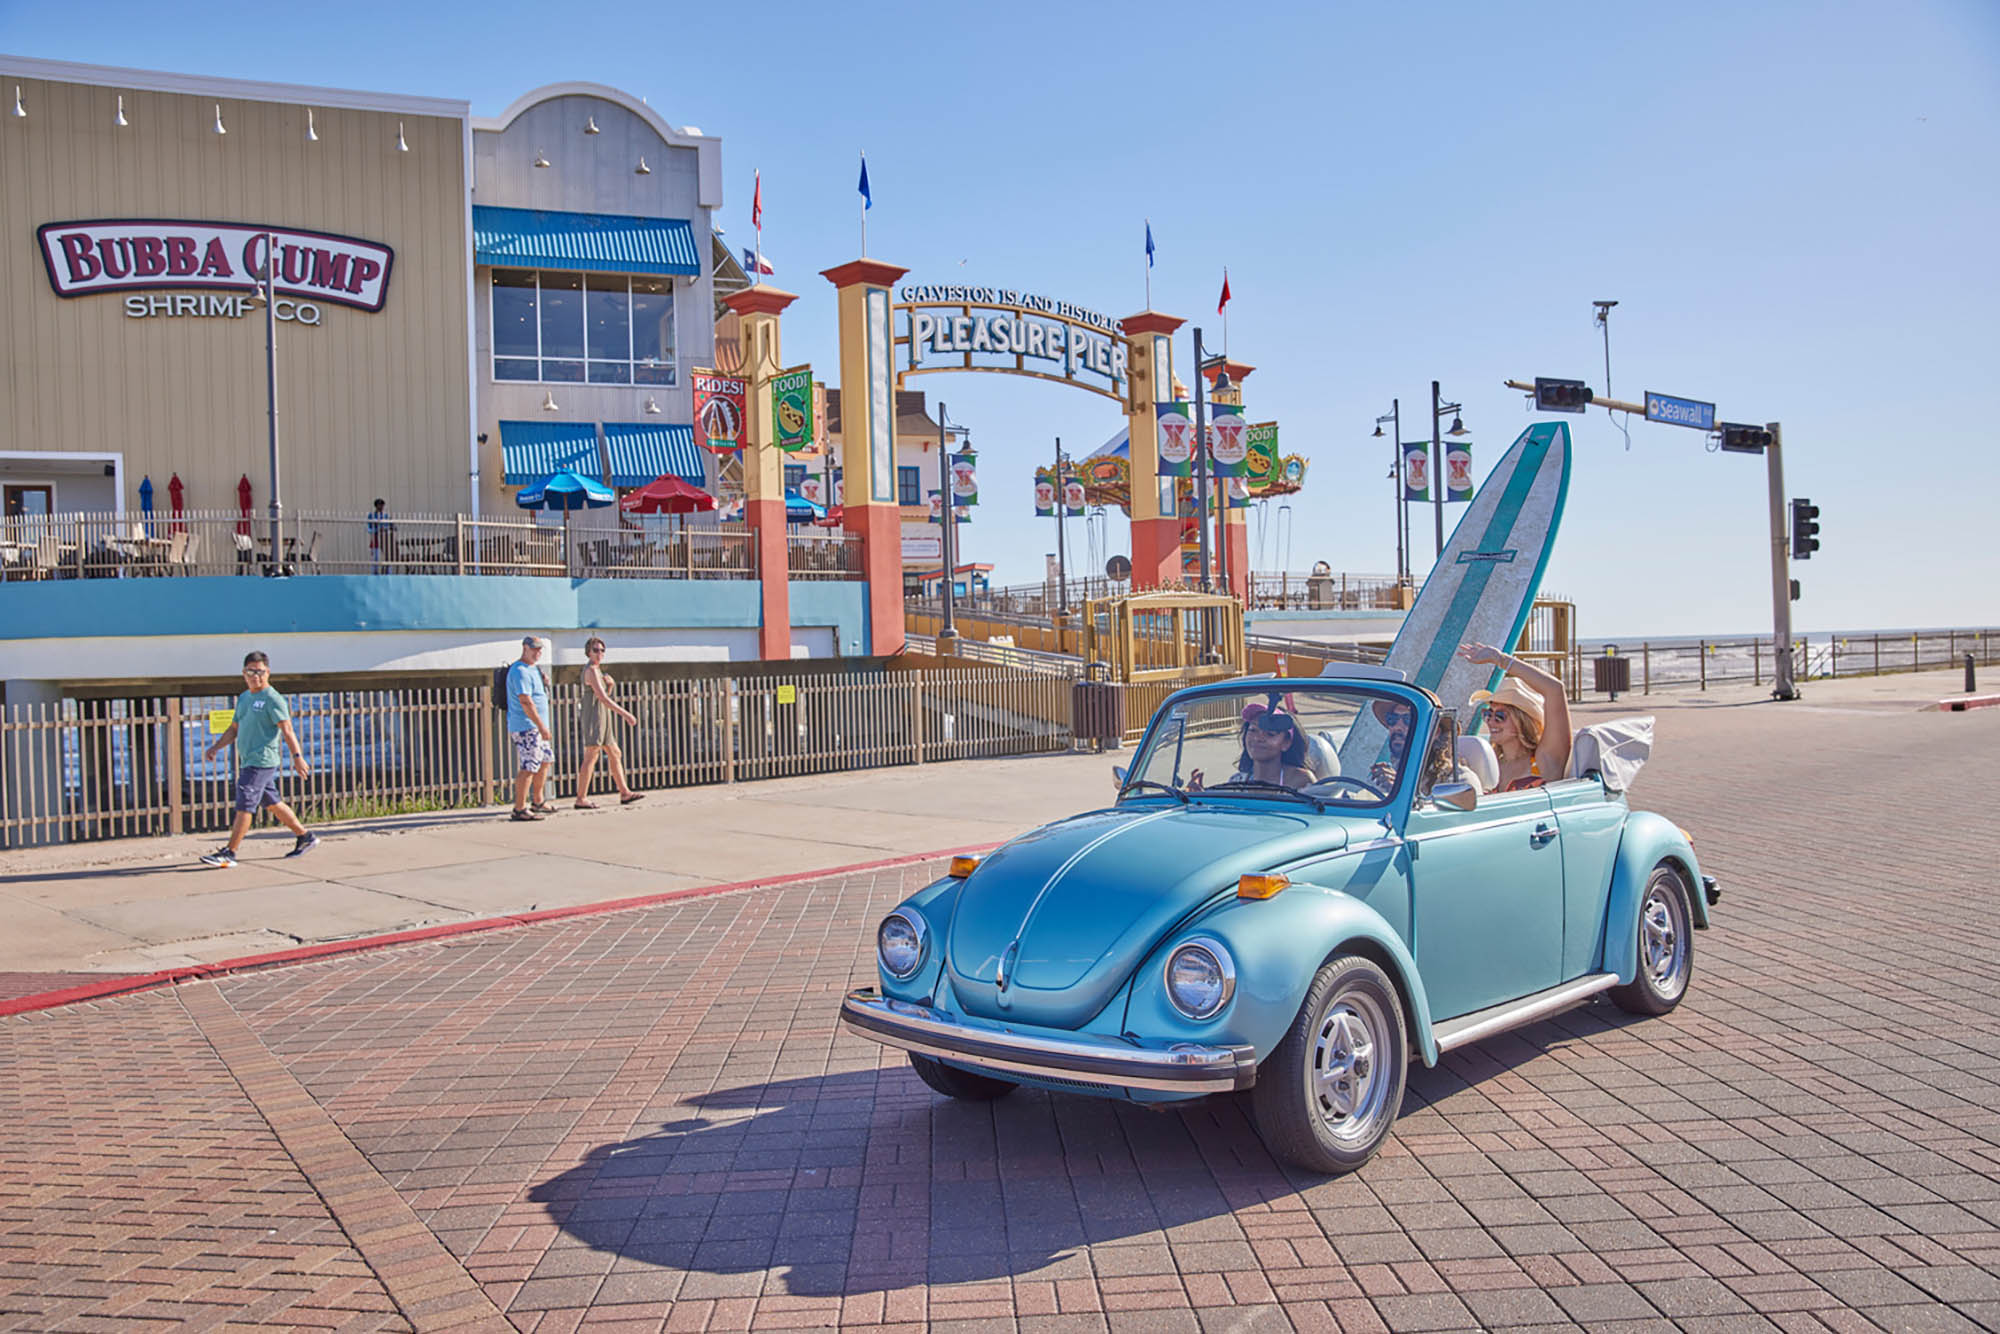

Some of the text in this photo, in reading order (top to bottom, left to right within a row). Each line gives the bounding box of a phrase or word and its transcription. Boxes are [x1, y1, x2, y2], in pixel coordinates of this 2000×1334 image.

[902, 285, 1124, 334] GALVESTON ISLAND HISTORIC
[908, 312, 1127, 384] PLEASURE PIER
[696, 377, 745, 395] RIDES!
[773, 374, 808, 394] FOOD!
[1660, 400, 1702, 424] Seawall
[1246, 429, 1275, 442] OOD!
